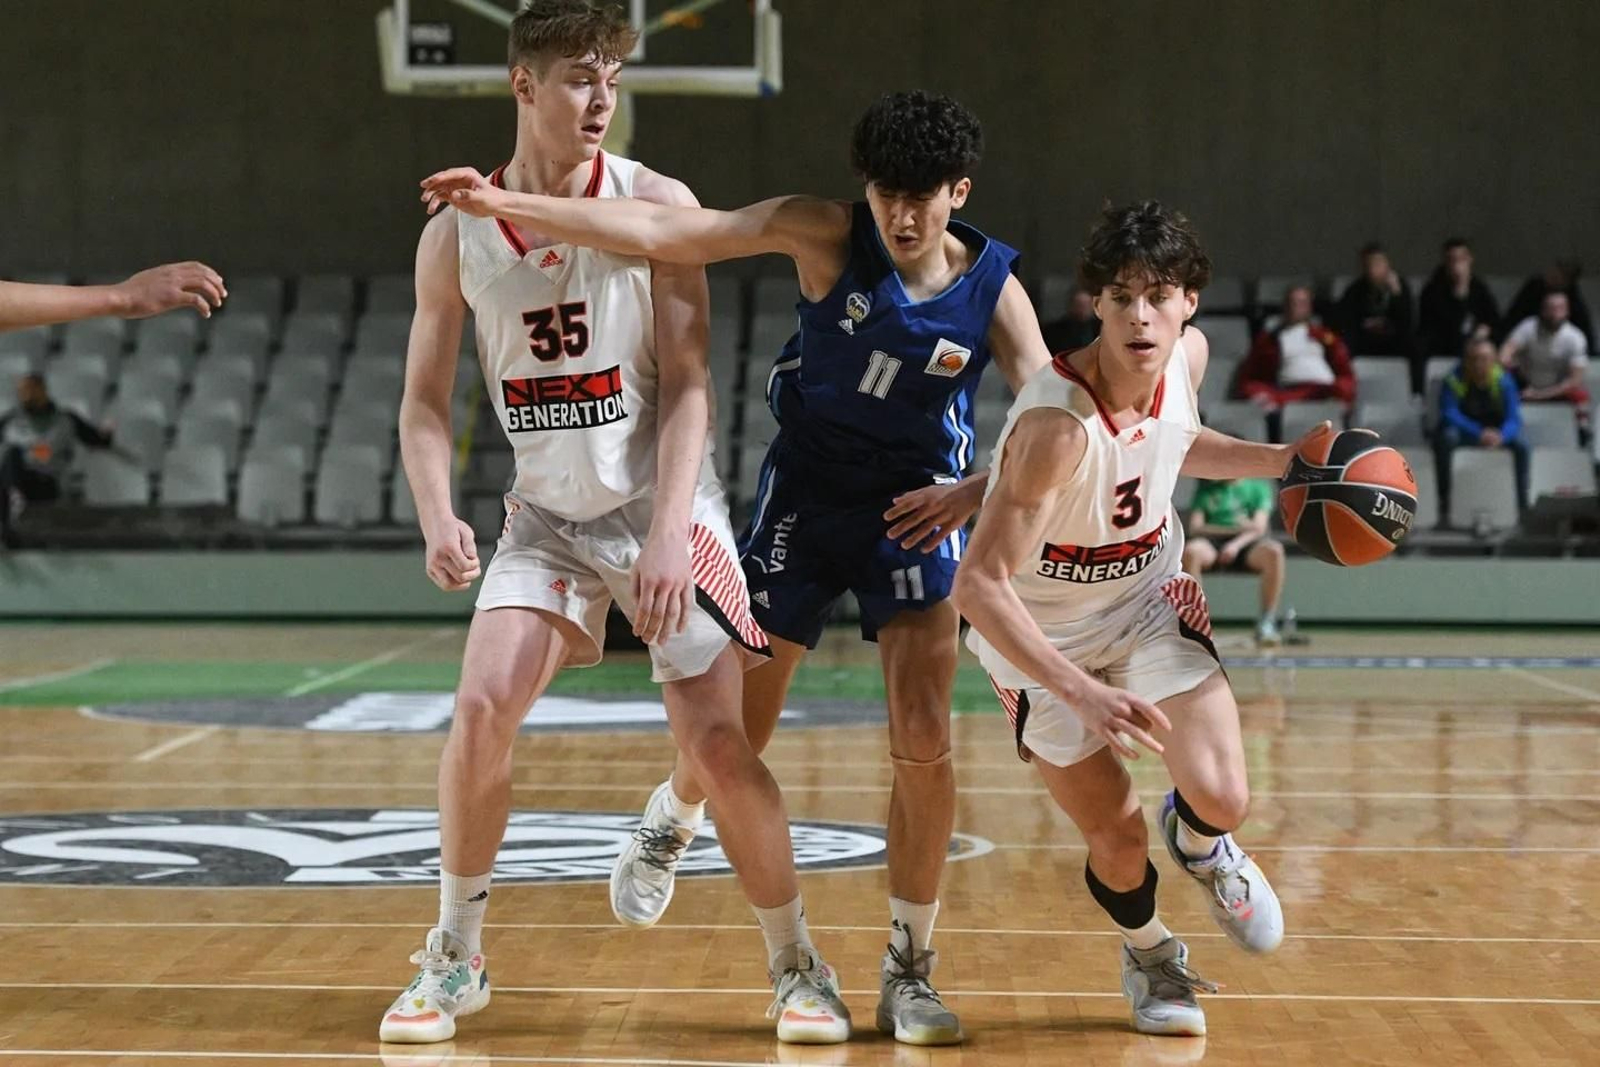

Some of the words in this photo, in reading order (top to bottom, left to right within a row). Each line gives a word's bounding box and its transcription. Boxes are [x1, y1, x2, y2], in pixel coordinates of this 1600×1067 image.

[522, 300, 589, 362] 35
[501, 364, 621, 407] NEXT
[857, 350, 902, 400] 11
[505, 393, 624, 431] GENERATION
[1111, 475, 1142, 530] 3
[890, 564, 925, 600] 11
